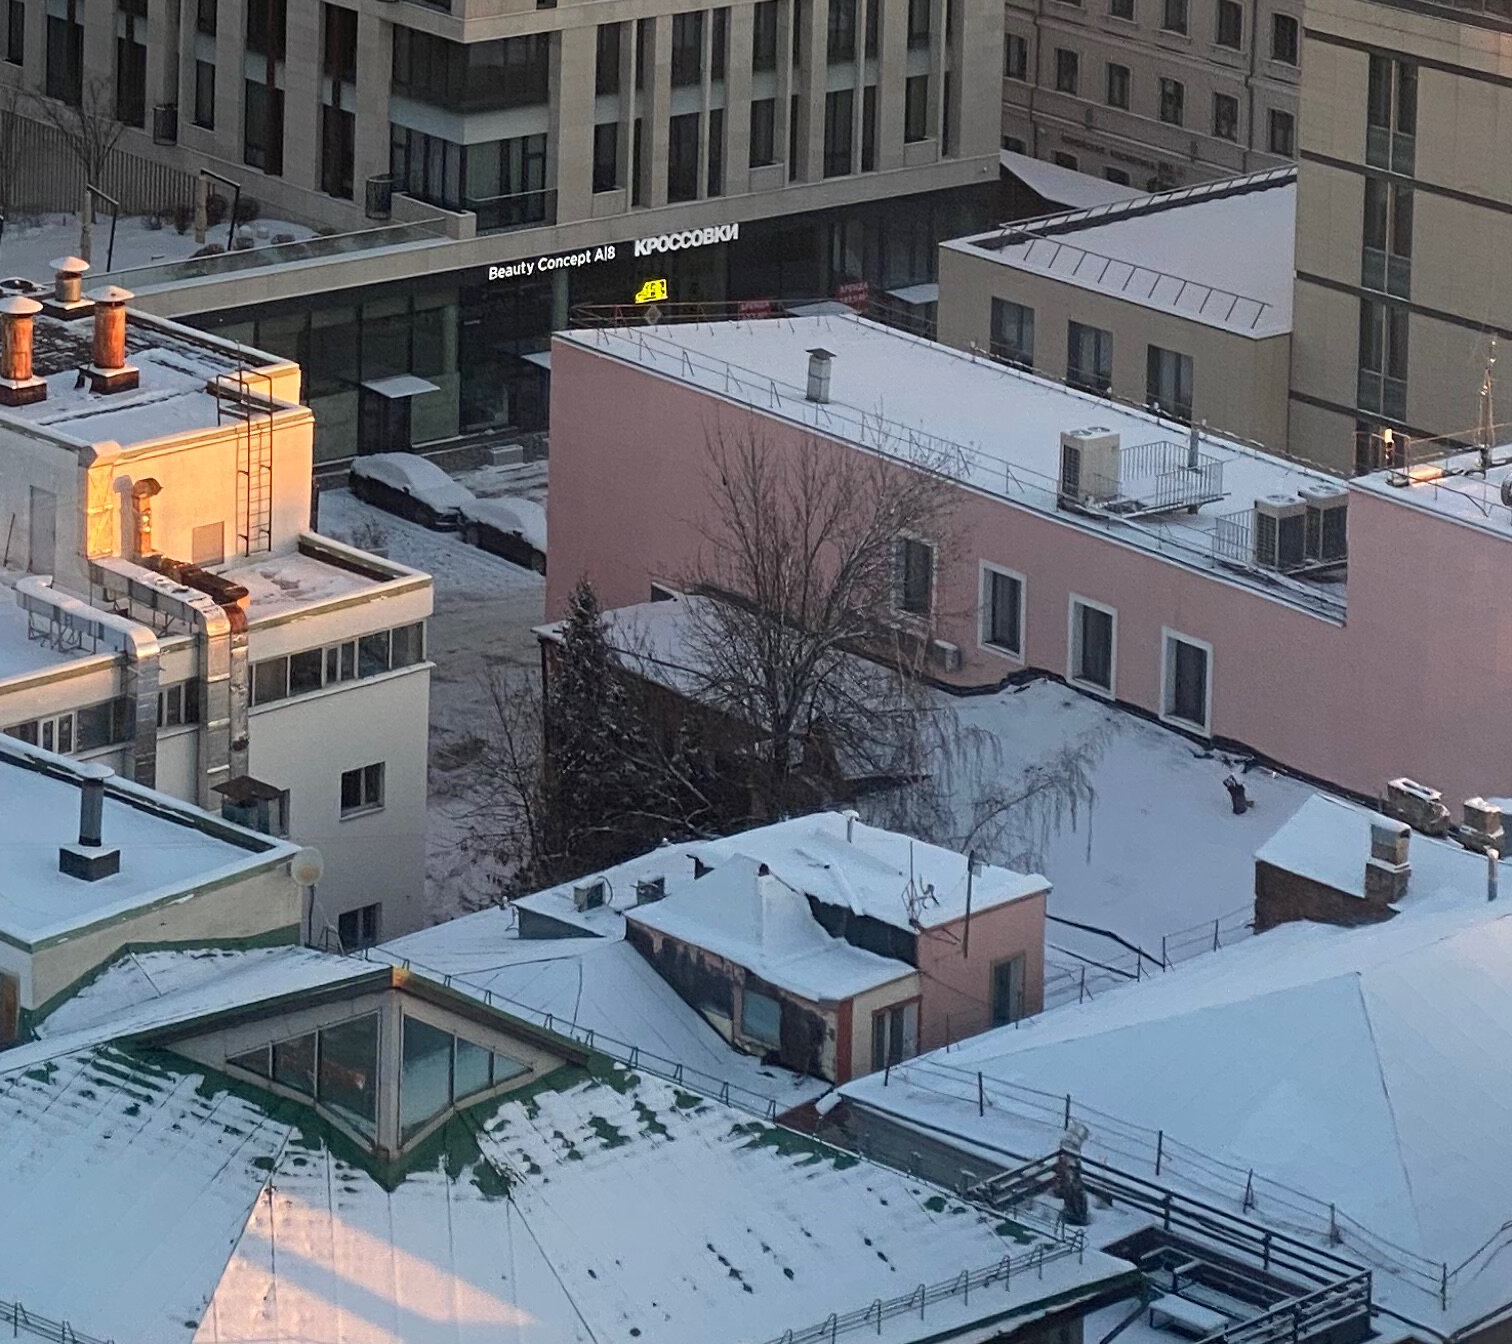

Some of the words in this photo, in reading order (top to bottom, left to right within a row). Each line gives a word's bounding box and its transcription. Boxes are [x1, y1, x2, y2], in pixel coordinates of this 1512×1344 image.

[634, 223, 739, 257] КРОССОВКИ
[488, 261, 534, 280] Beauty
[537, 249, 591, 272] Concept
